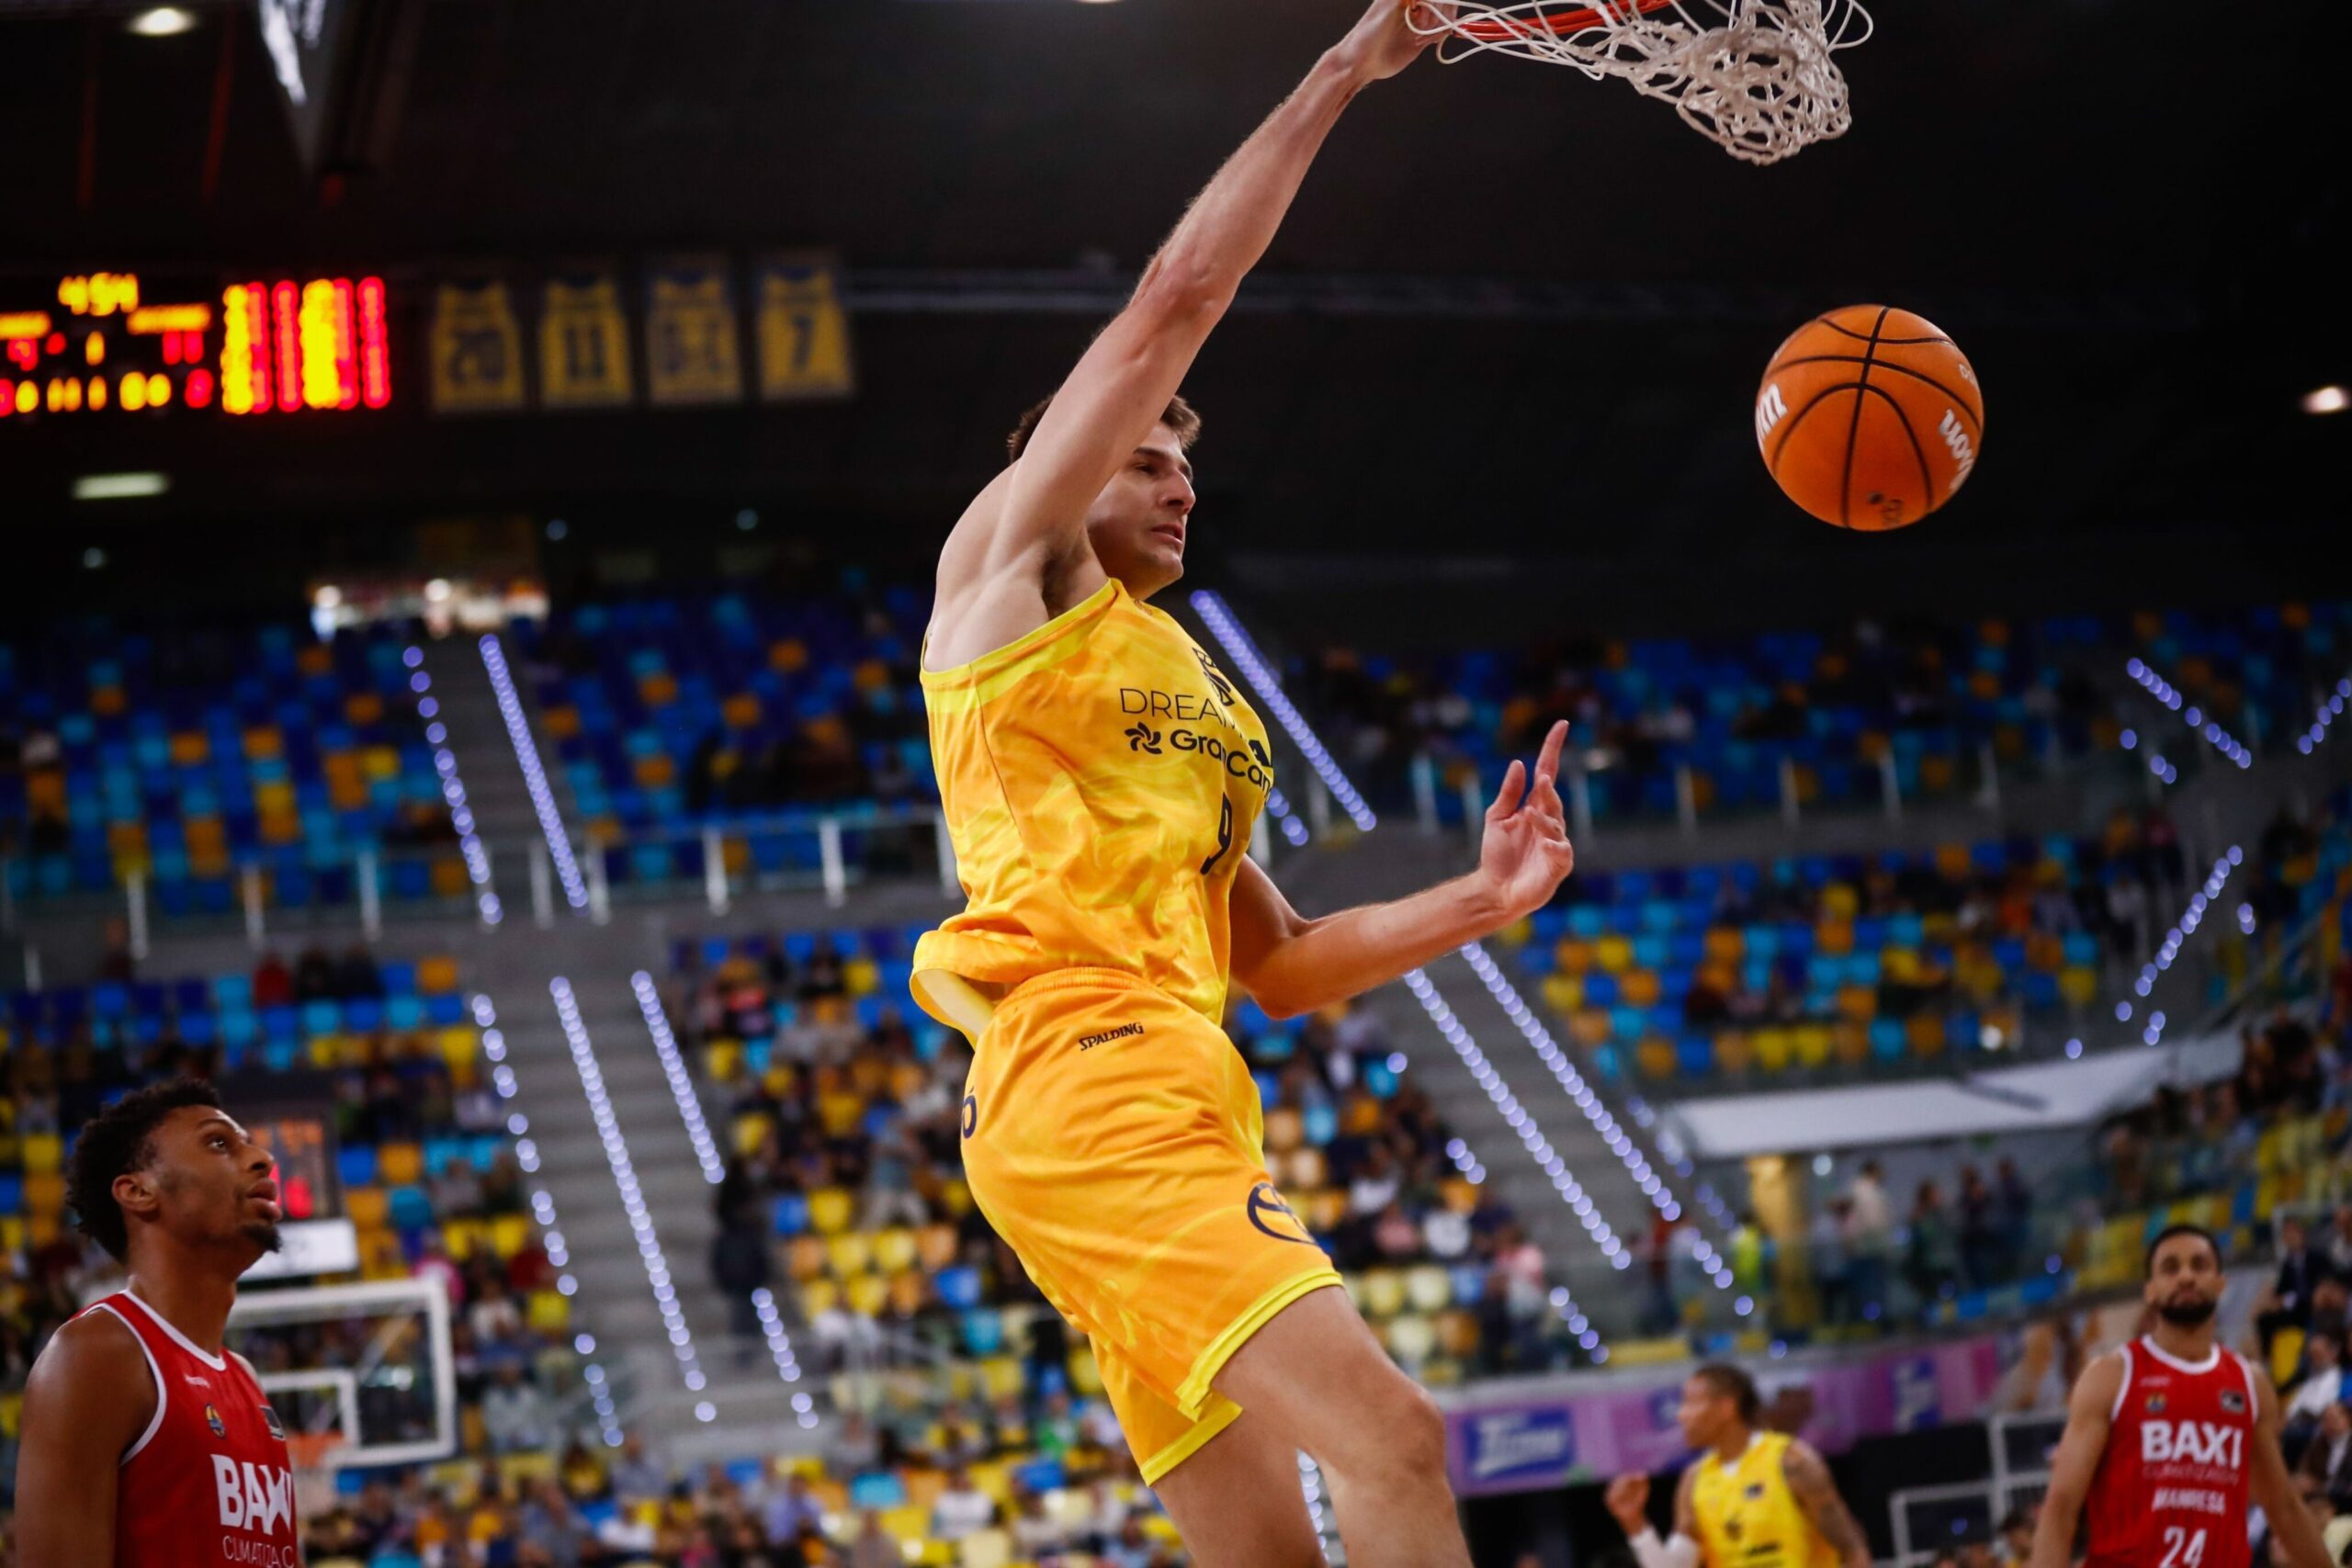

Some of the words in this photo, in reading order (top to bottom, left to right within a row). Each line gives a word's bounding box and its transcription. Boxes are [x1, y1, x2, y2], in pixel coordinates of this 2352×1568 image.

[1079, 1021, 1144, 1051] SPALDING
[2141, 1420, 2244, 1470] BAXI
[2159, 1526, 2207, 1568] 24
